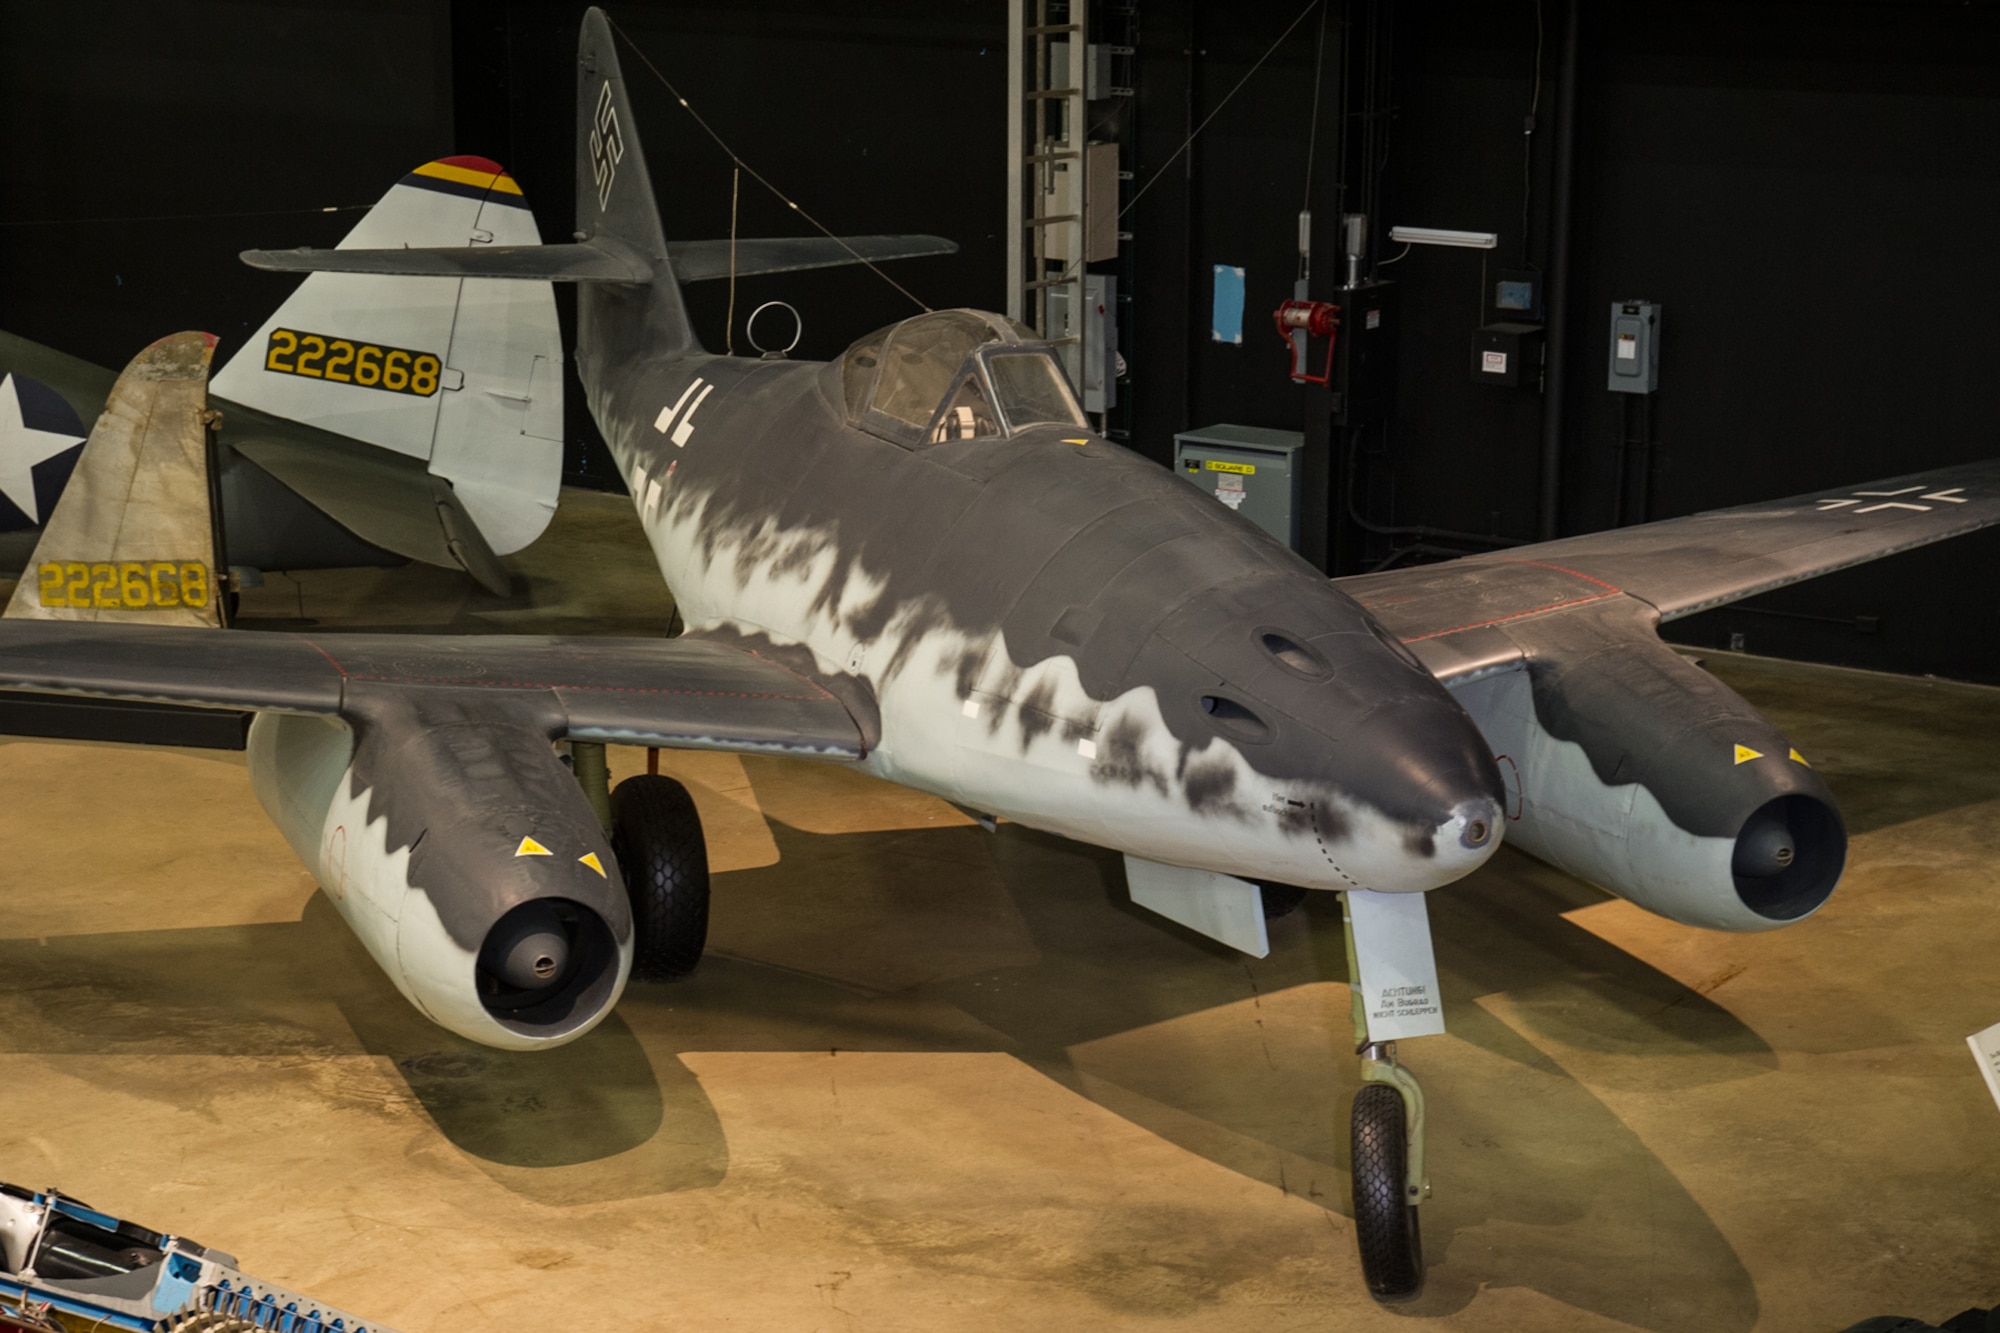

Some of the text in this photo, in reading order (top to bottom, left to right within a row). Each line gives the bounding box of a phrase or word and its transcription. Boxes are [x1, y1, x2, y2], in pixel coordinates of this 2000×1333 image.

[267, 329, 440, 396] 222668
[1214, 463, 1243, 471] SQUARE
[39, 562, 208, 607] 222668
